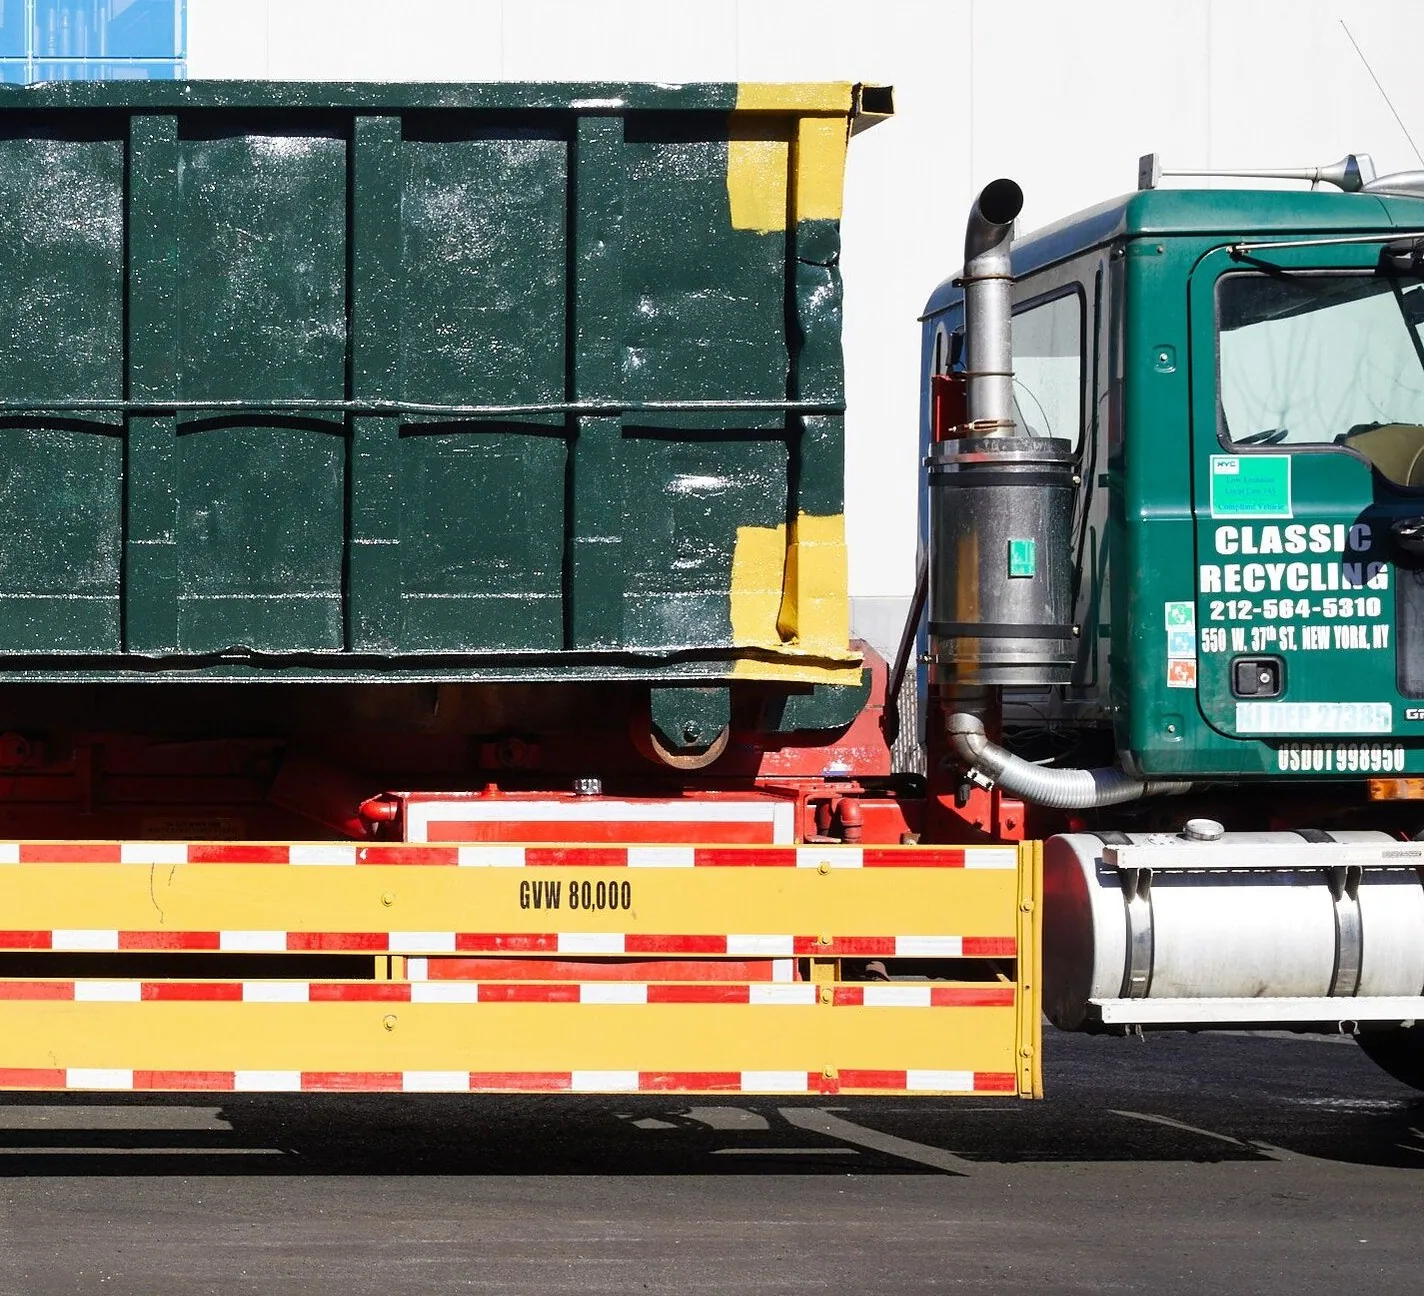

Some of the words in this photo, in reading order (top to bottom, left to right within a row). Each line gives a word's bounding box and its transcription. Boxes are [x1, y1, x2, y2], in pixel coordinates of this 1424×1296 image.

[1215, 524, 1372, 555] CLASSIC
[1200, 562, 1389, 593] RECYCLING
[1210, 598, 1381, 620] 212-564-5310
[1202, 628, 1226, 652] 550
[1232, 628, 1247, 652] W.
[1251, 626, 1276, 651] 37th
[1302, 625, 1330, 650] NEW
[1334, 625, 1370, 650] YORK,
[1373, 625, 1389, 649] NY
[1279, 743, 1333, 771] USDOT
[1336, 743, 1404, 771] 998950
[520, 881, 561, 909] GVW
[569, 881, 631, 912] 80,000
